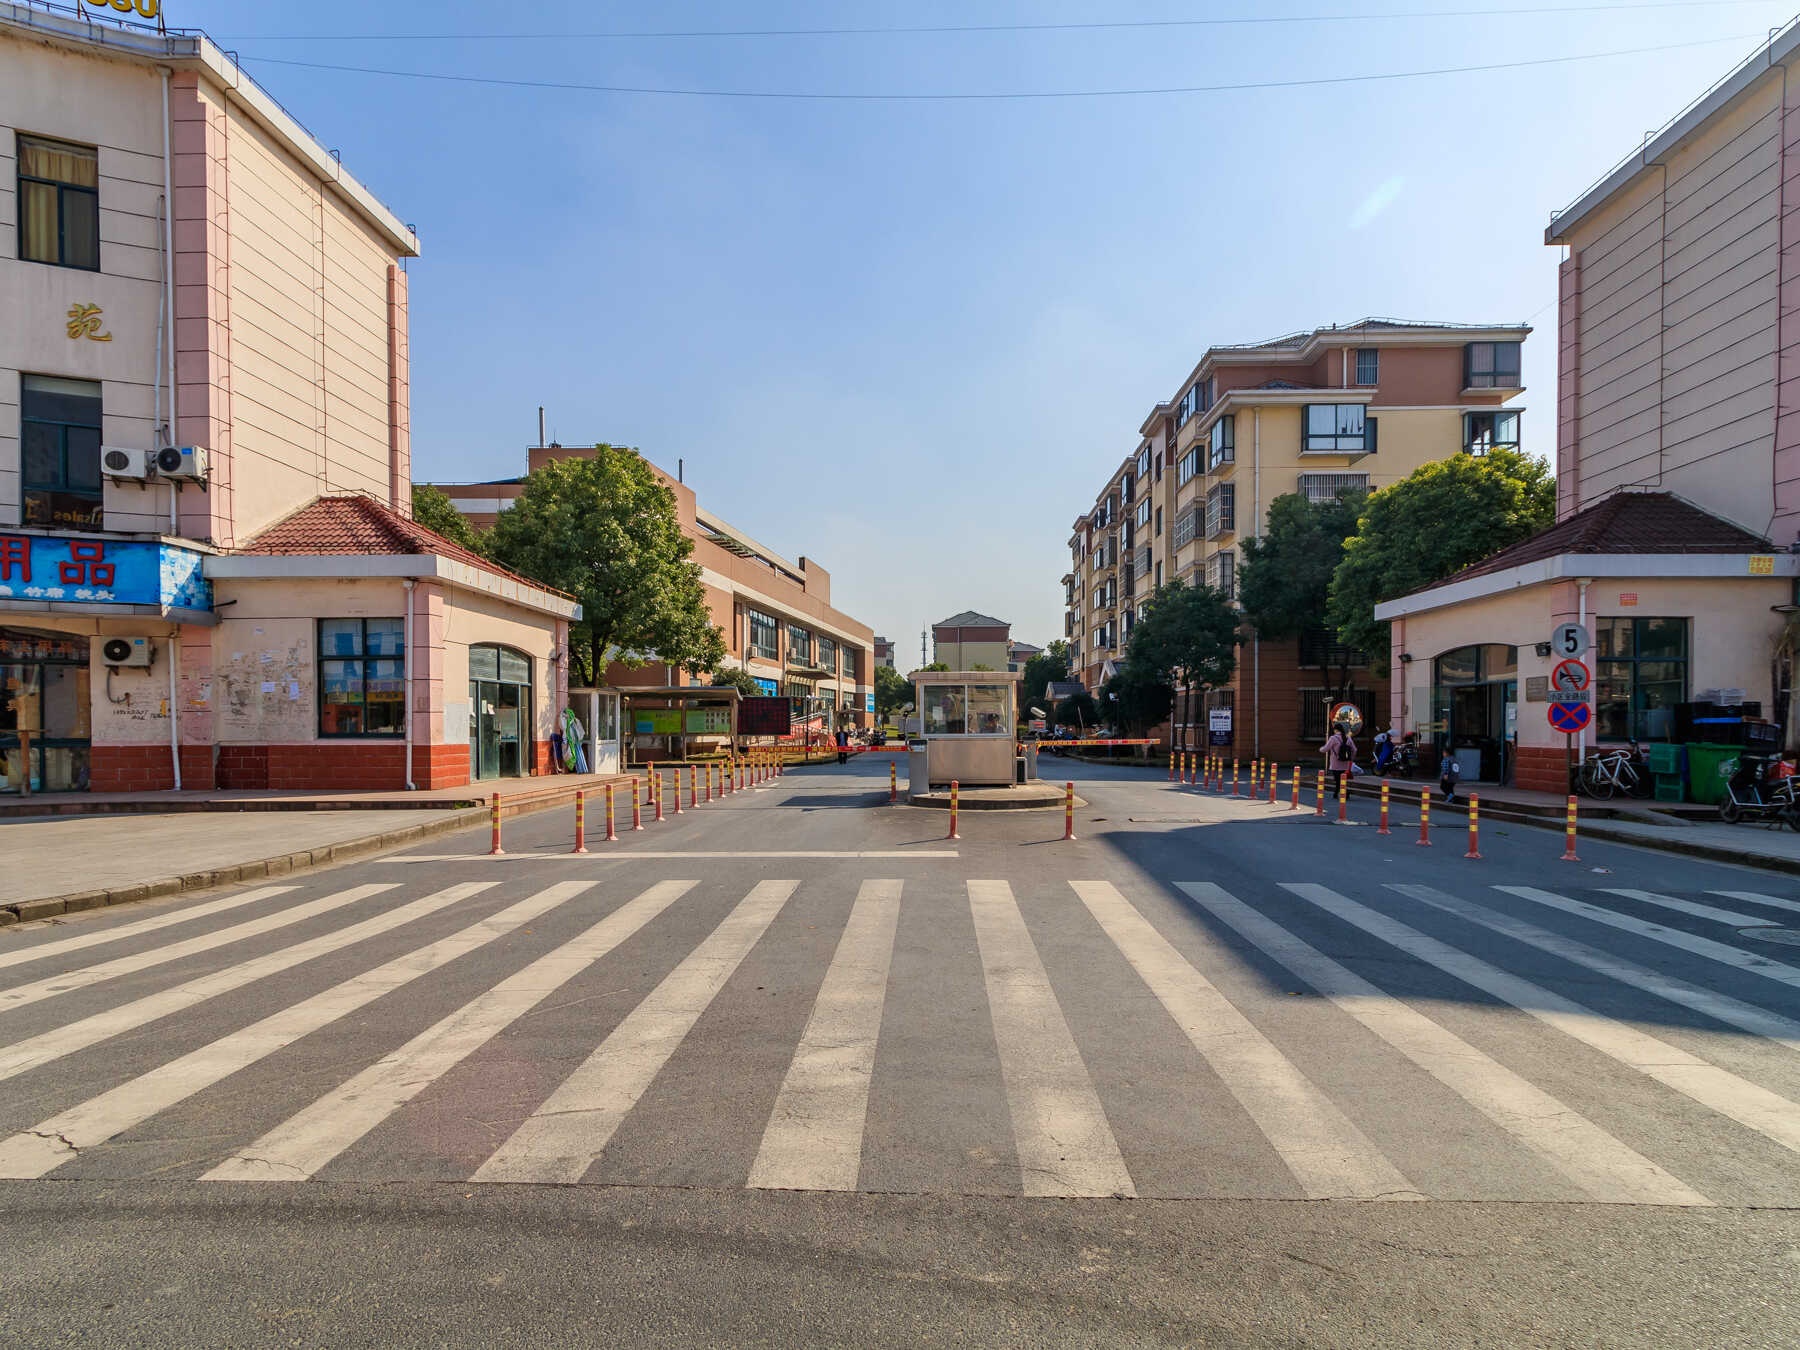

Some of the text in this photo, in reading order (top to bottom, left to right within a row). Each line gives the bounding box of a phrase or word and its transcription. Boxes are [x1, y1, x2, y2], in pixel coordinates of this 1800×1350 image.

[66, 303, 112, 341] 苑
[0, 537, 115, 586] 用品
[1565, 628, 1578, 653] 5
